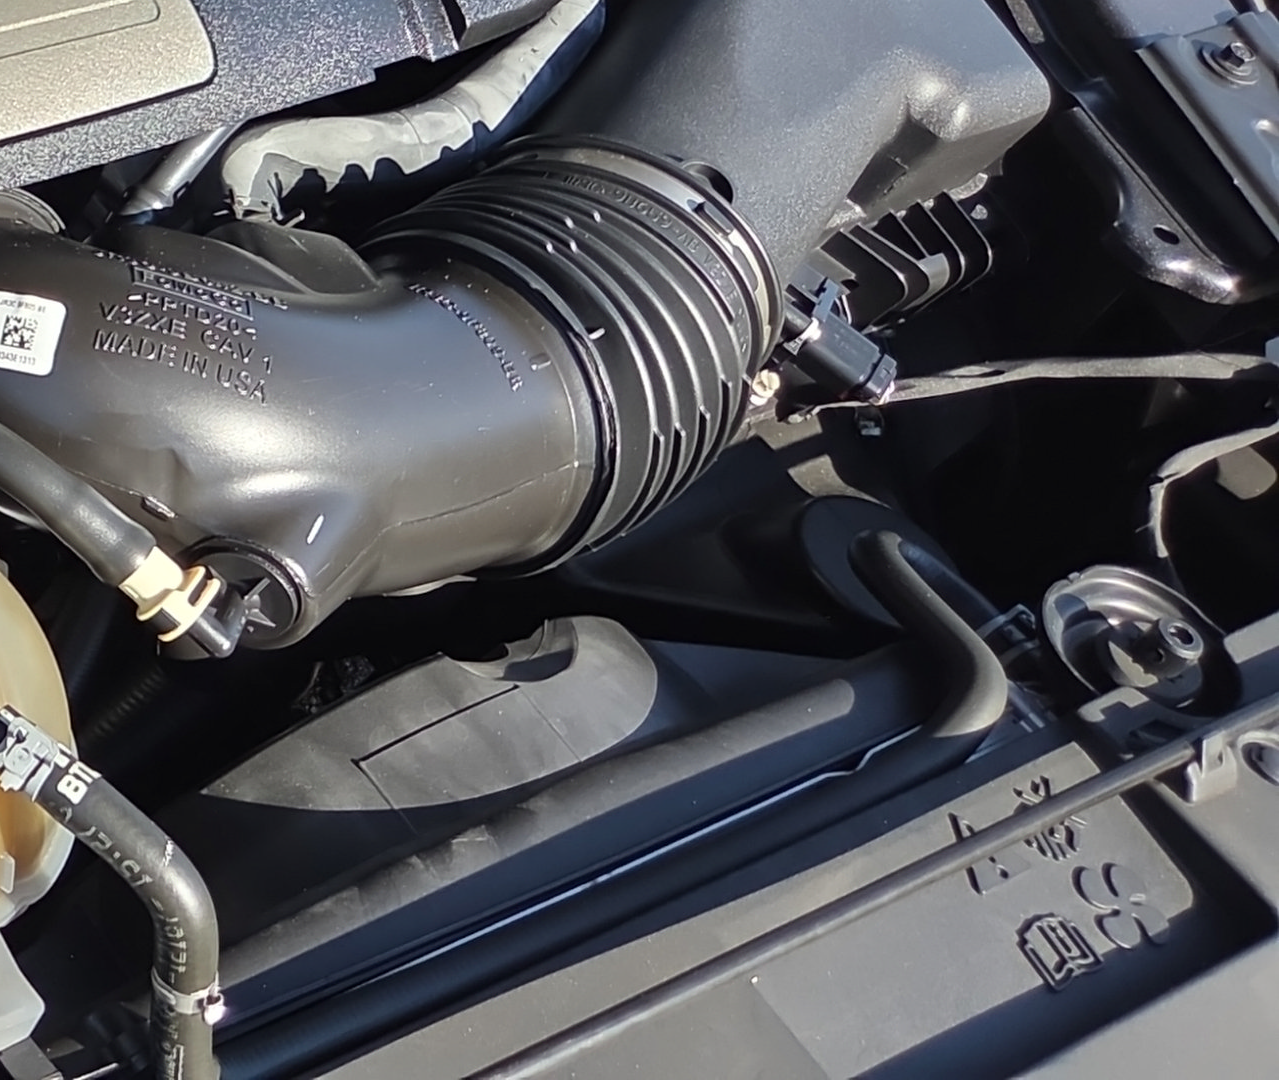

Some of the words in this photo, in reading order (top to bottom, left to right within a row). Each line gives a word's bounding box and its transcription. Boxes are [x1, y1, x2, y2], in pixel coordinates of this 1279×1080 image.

[93, 328, 178, 368] MADE
[183, 350, 208, 379] IN
[216, 363, 268, 407] USA
